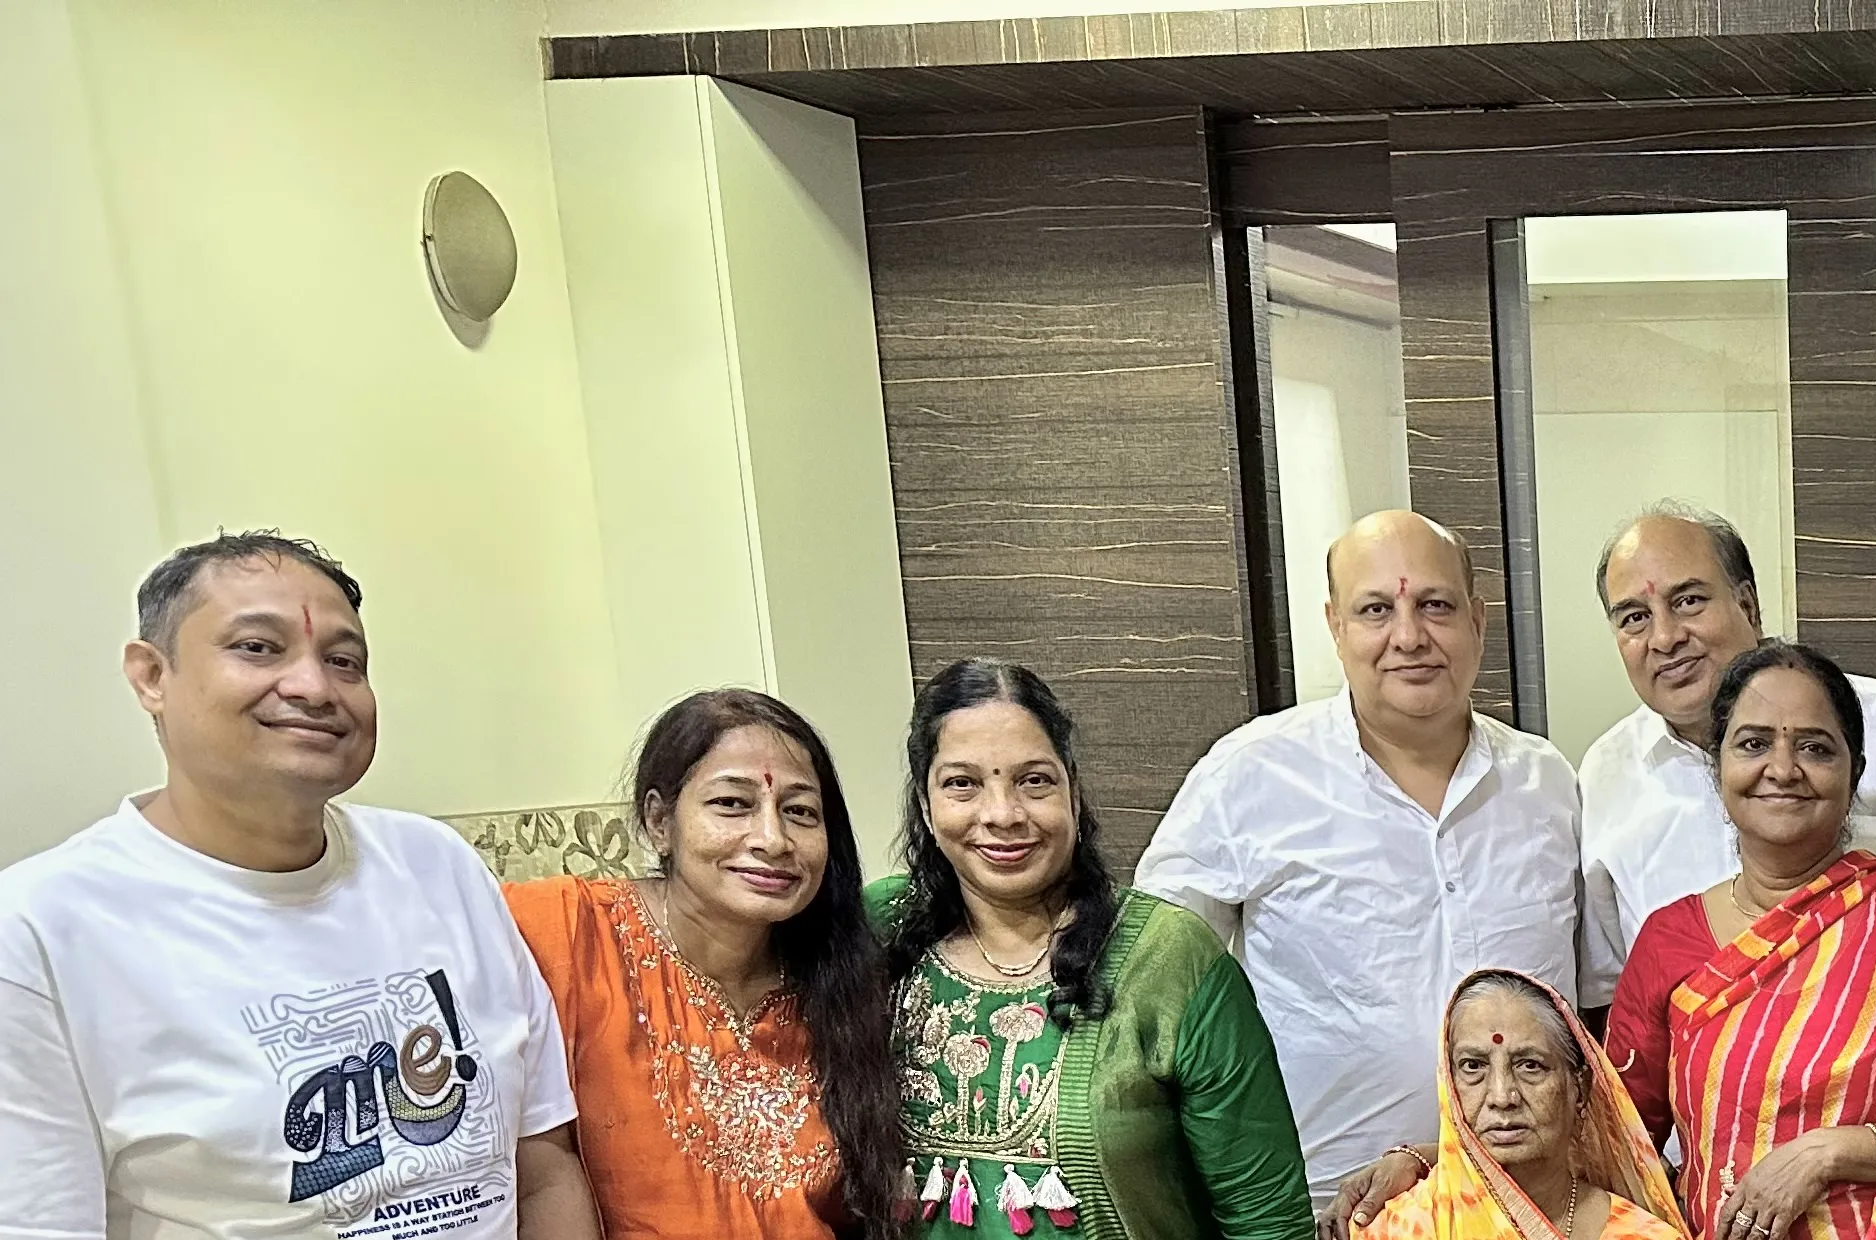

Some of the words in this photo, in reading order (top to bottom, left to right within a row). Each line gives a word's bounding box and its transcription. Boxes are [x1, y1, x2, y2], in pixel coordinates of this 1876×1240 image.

[373, 1184, 481, 1222] ADVENTURE
[337, 1223, 391, 1240] HAPPINESS
[403, 1220, 411, 1228] A
[411, 1216, 430, 1226] WAY
[432, 1208, 465, 1221] STATION
[392, 1230, 419, 1240] MUCH
[421, 1226, 439, 1236] AND
[440, 1222, 456, 1231] TOO
